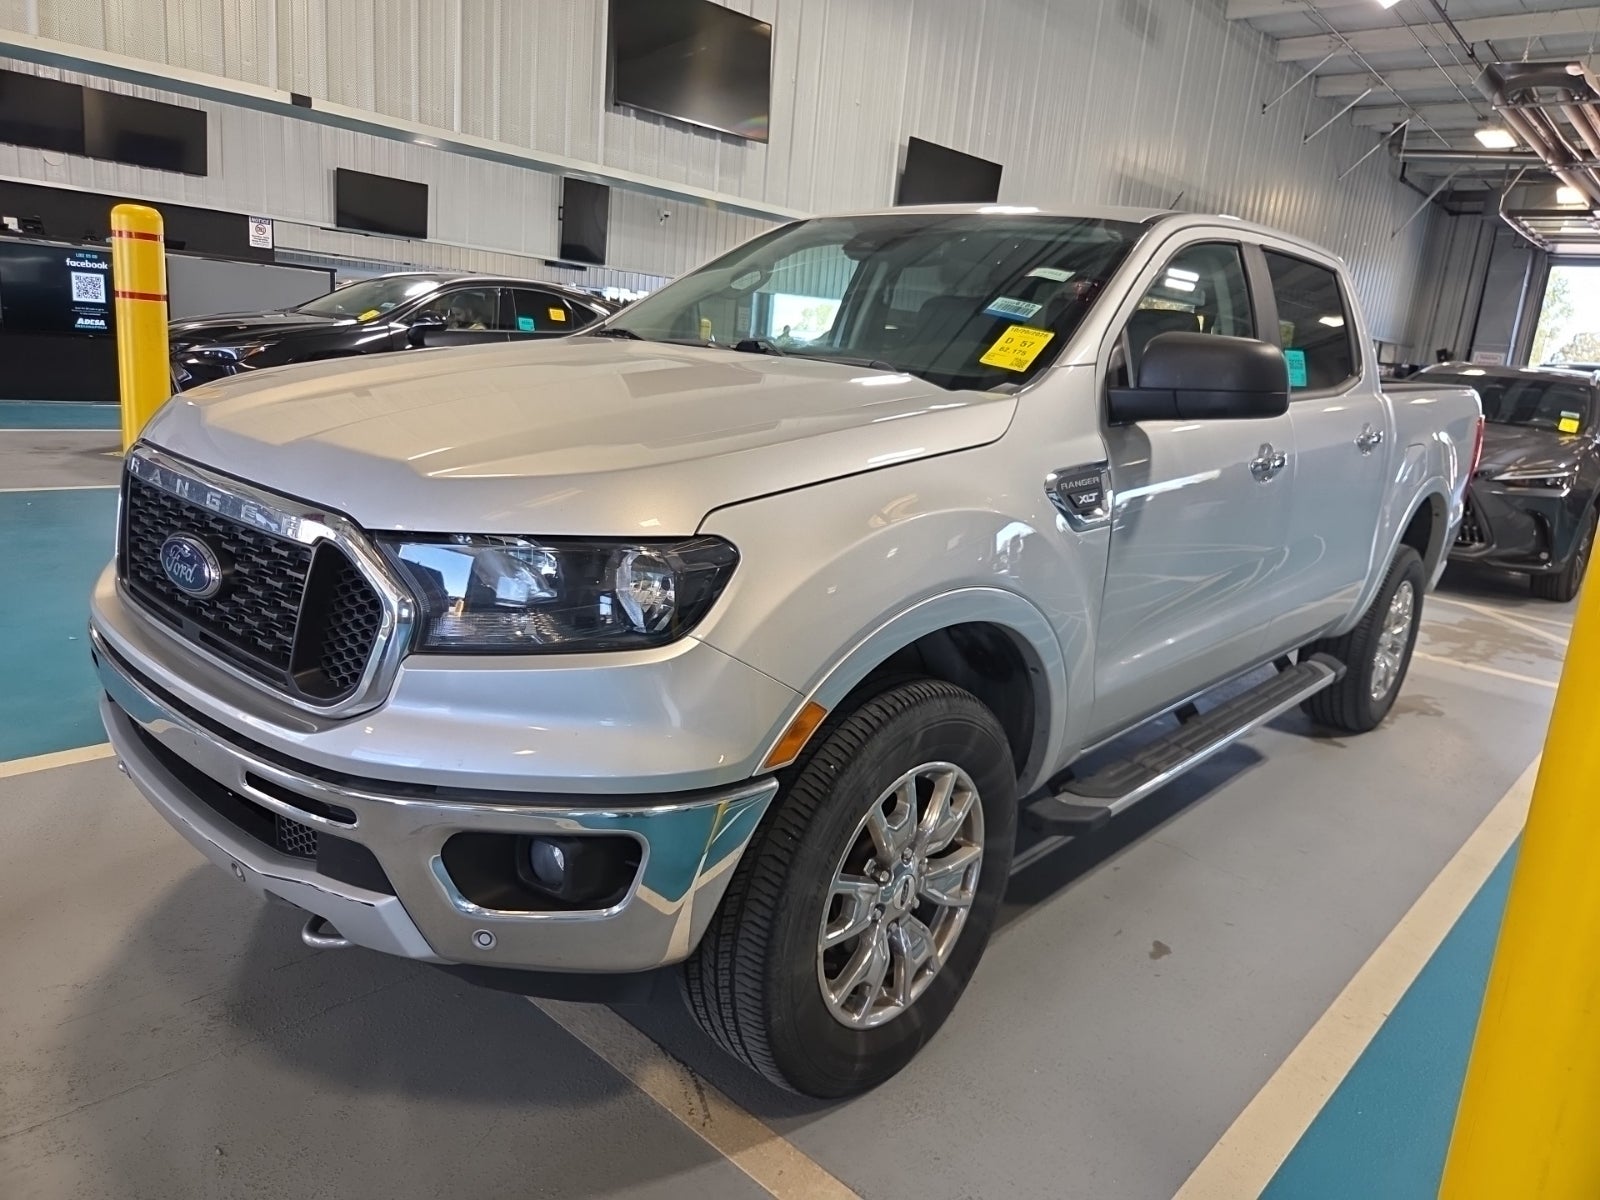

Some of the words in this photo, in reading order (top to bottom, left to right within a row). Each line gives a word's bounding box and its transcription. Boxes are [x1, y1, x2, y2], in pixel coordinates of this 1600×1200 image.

[66, 258, 108, 269] facebook
[1020, 340, 1035, 348] 57
[1060, 476, 1100, 490] RANGER
[131, 456, 300, 540] RANGER
[1078, 492, 1099, 504] XLT
[165, 544, 196, 584] Ford
